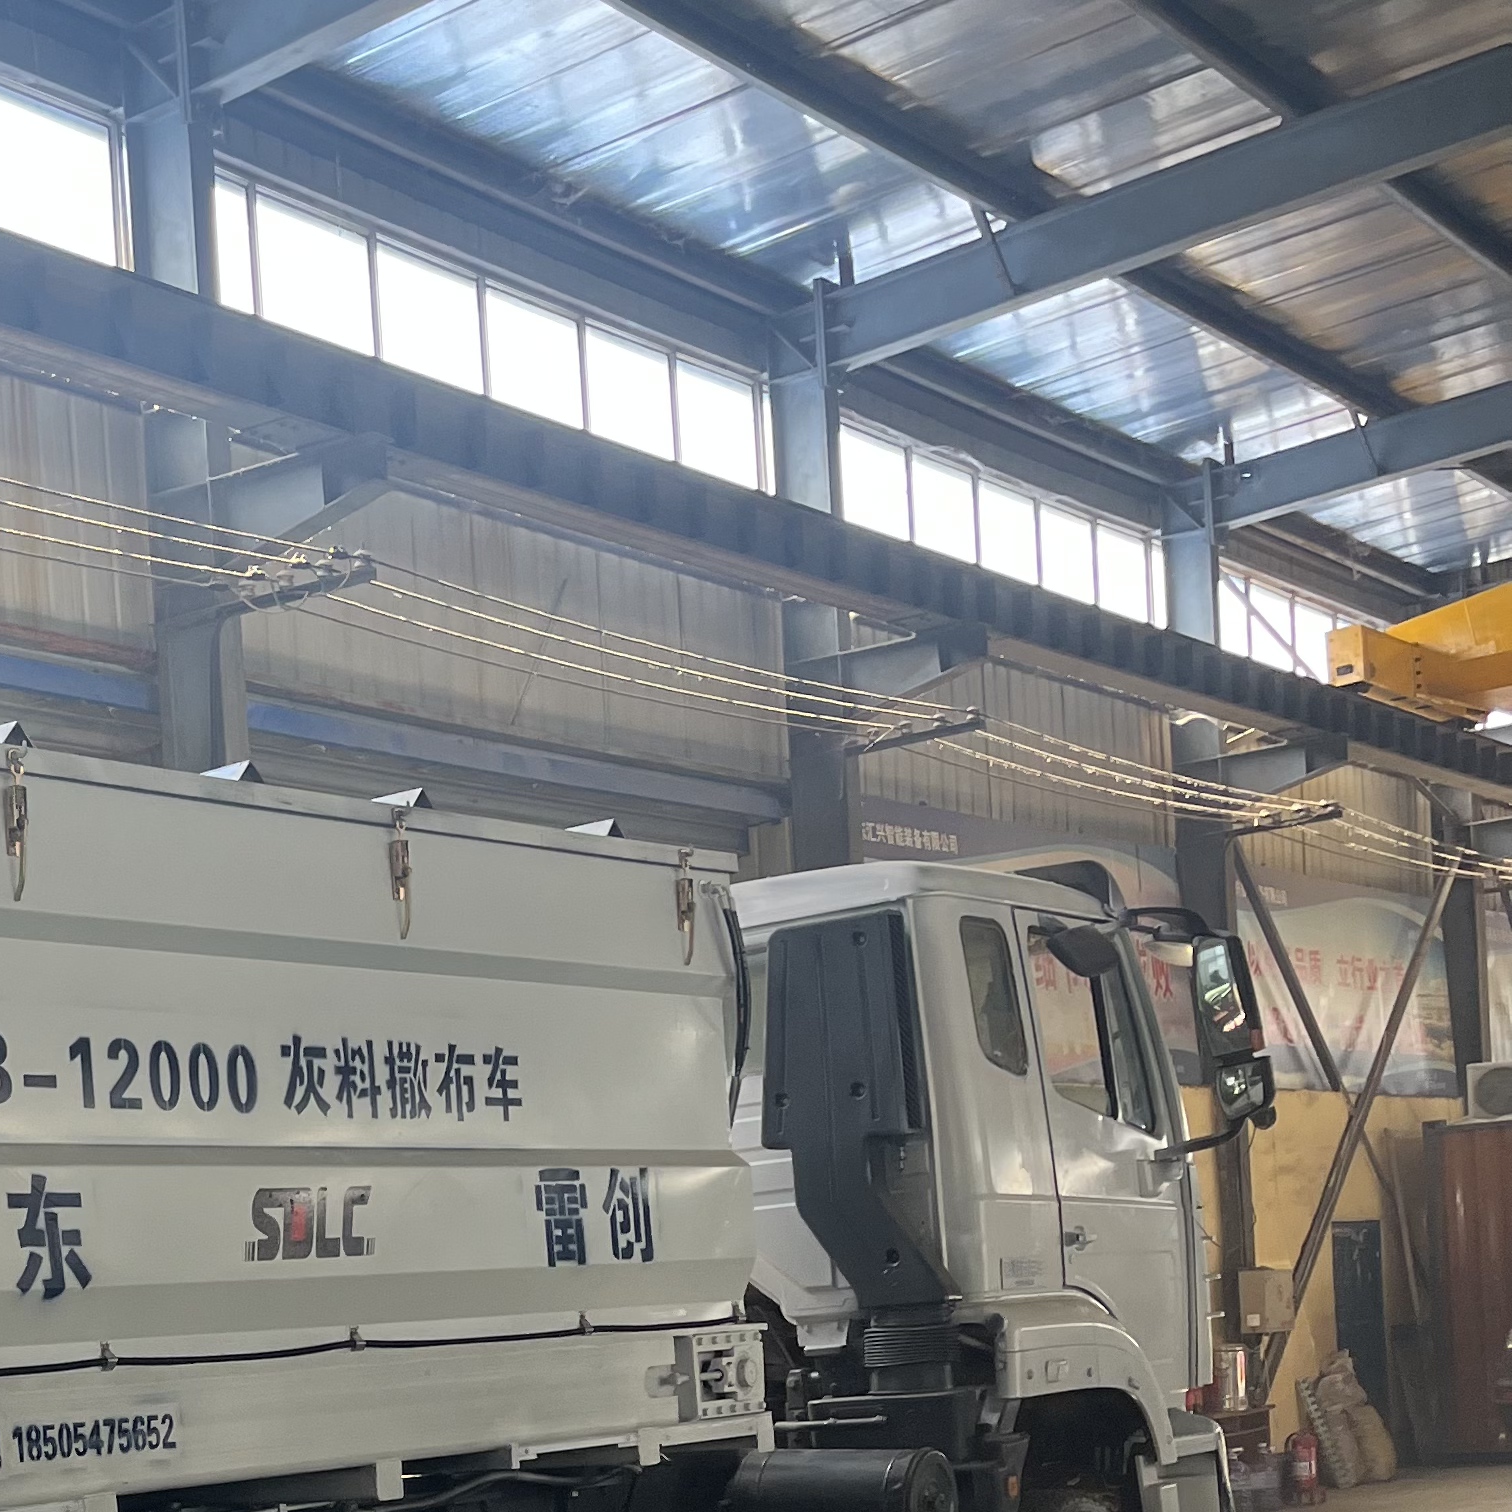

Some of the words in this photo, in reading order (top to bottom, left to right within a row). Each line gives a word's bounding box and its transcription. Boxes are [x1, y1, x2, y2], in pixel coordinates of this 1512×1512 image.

[280, 1034, 523, 1122] 灰料撒布车
[245, 1185, 376, 1262] SDLC
[534, 1167, 655, 1267] 雷创
[11, 1413, 177, 1463] 18505475652
